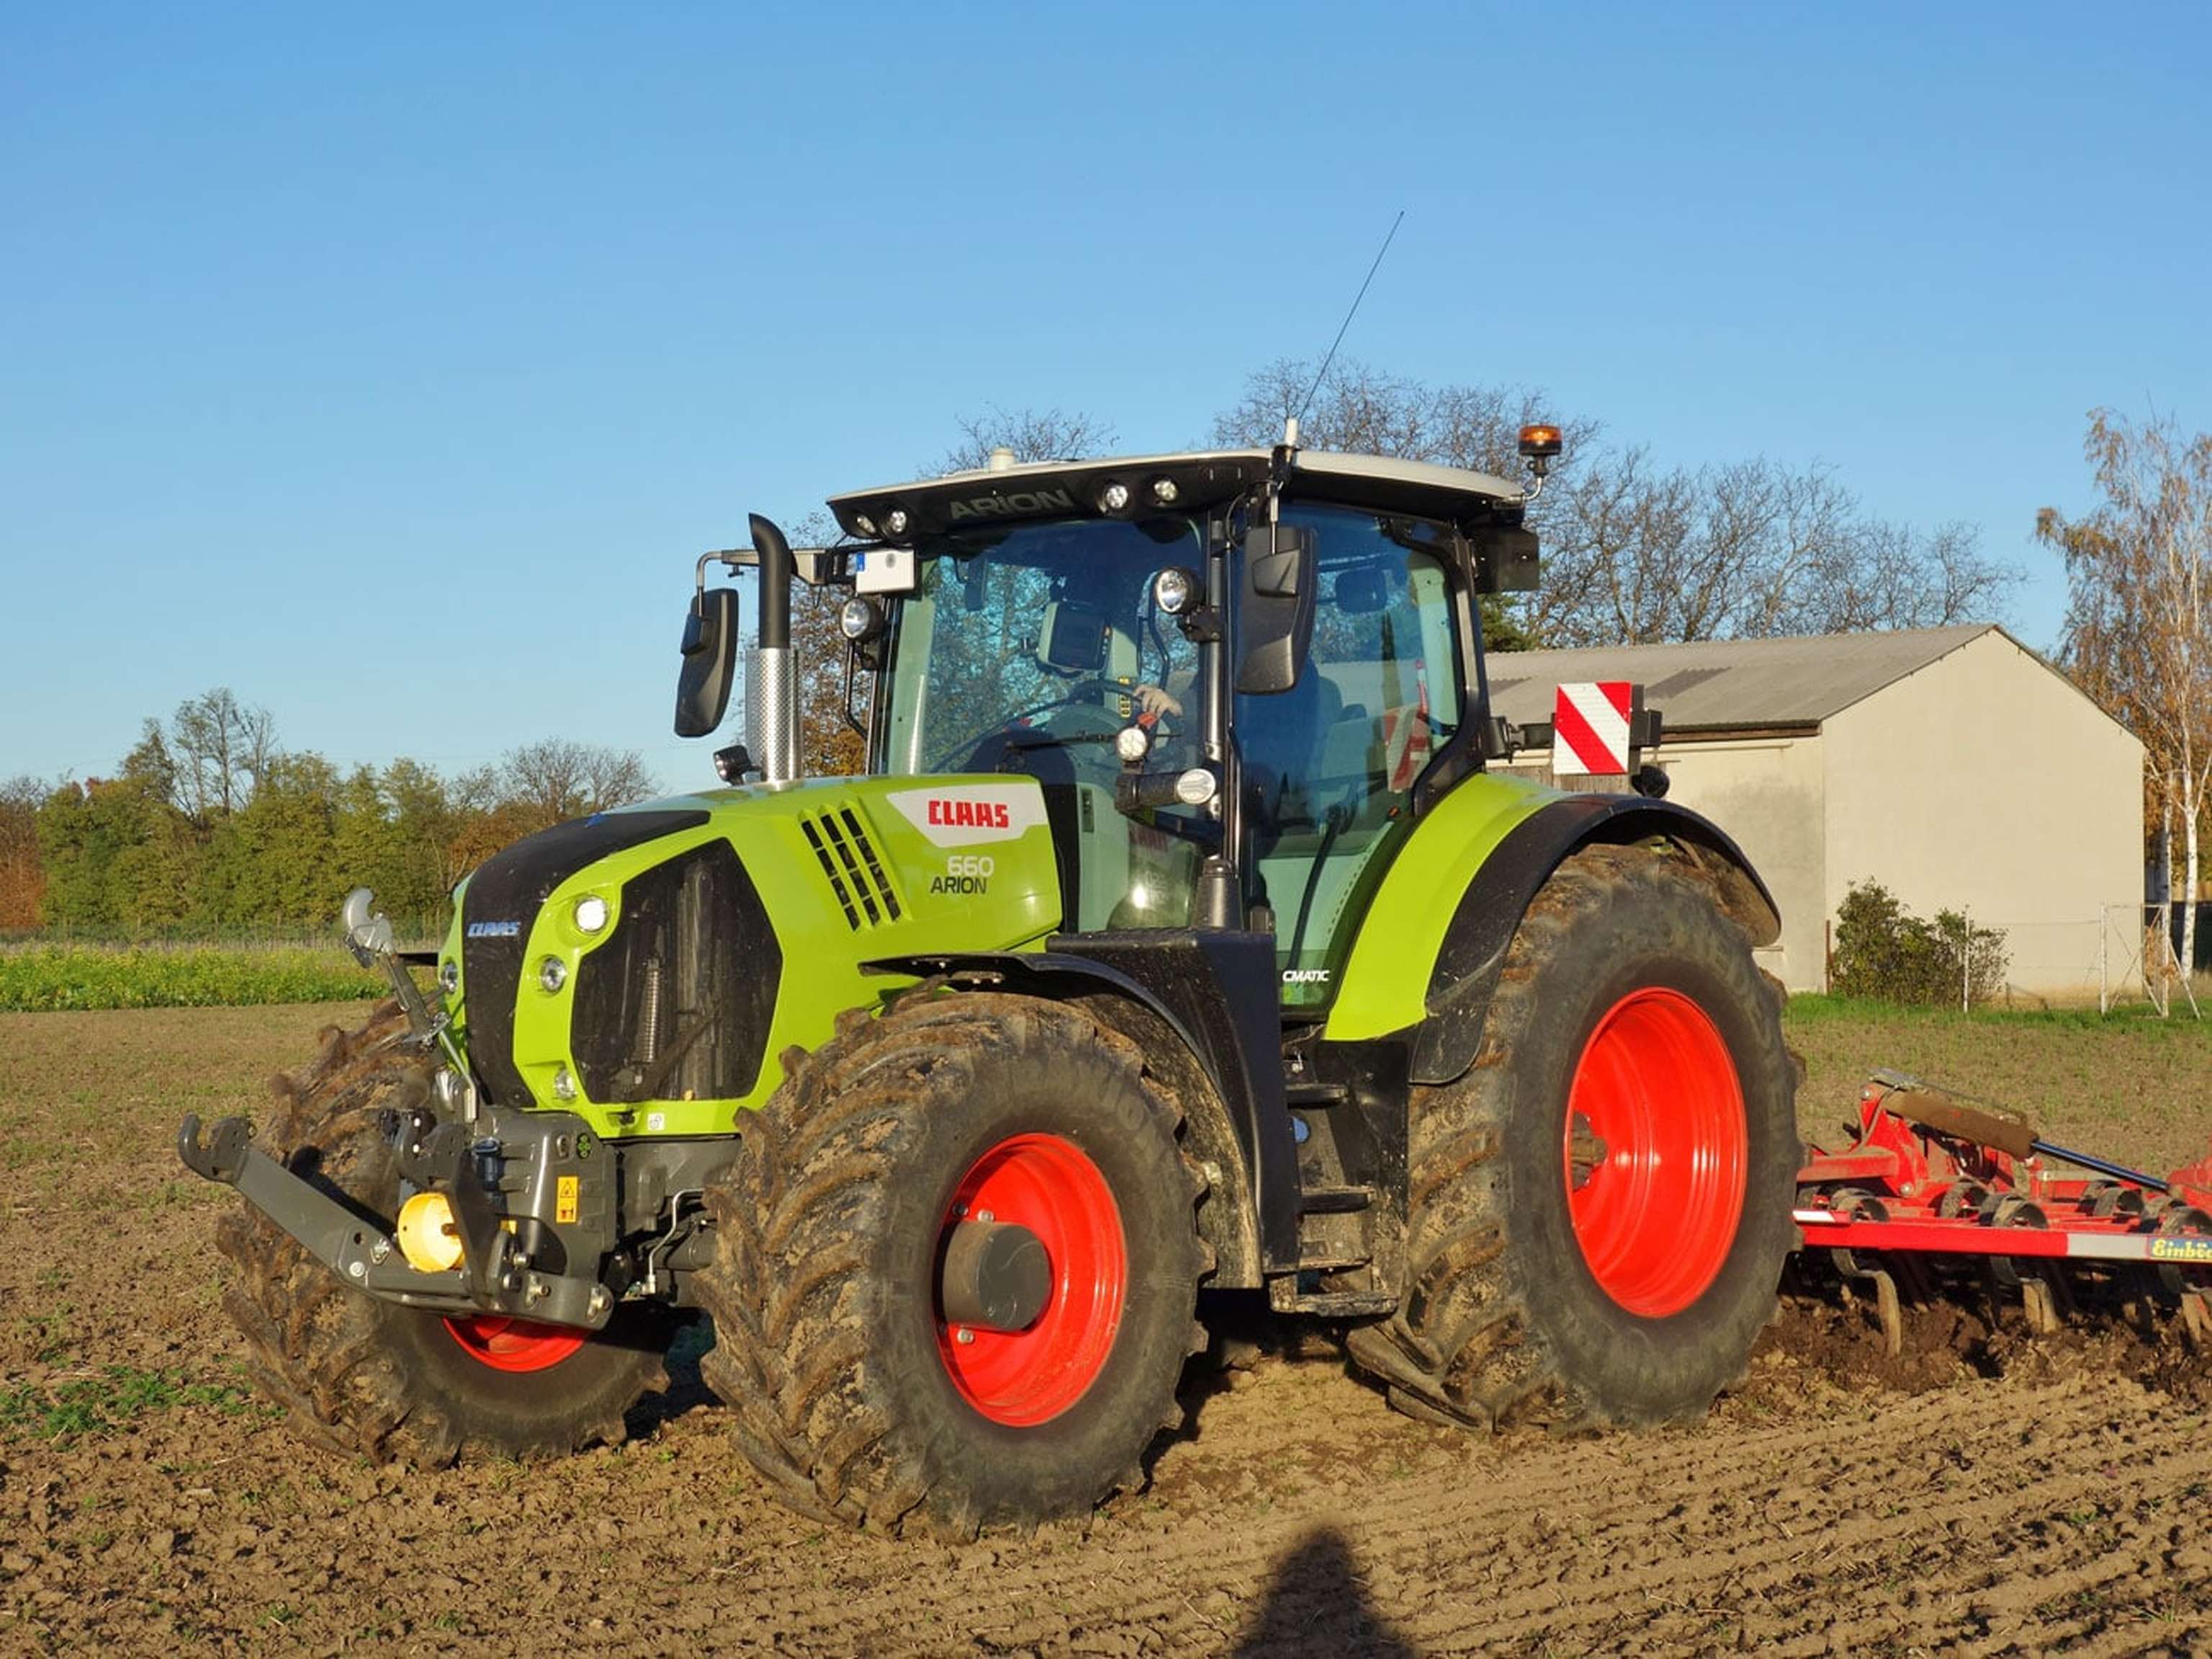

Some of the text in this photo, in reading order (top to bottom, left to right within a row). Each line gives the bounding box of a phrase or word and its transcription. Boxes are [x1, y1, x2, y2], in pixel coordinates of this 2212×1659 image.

[950, 489, 1075, 520] ARION
[929, 800, 1009, 828] CLAAS
[947, 855, 995, 877] 660
[930, 876, 987, 894] ARION
